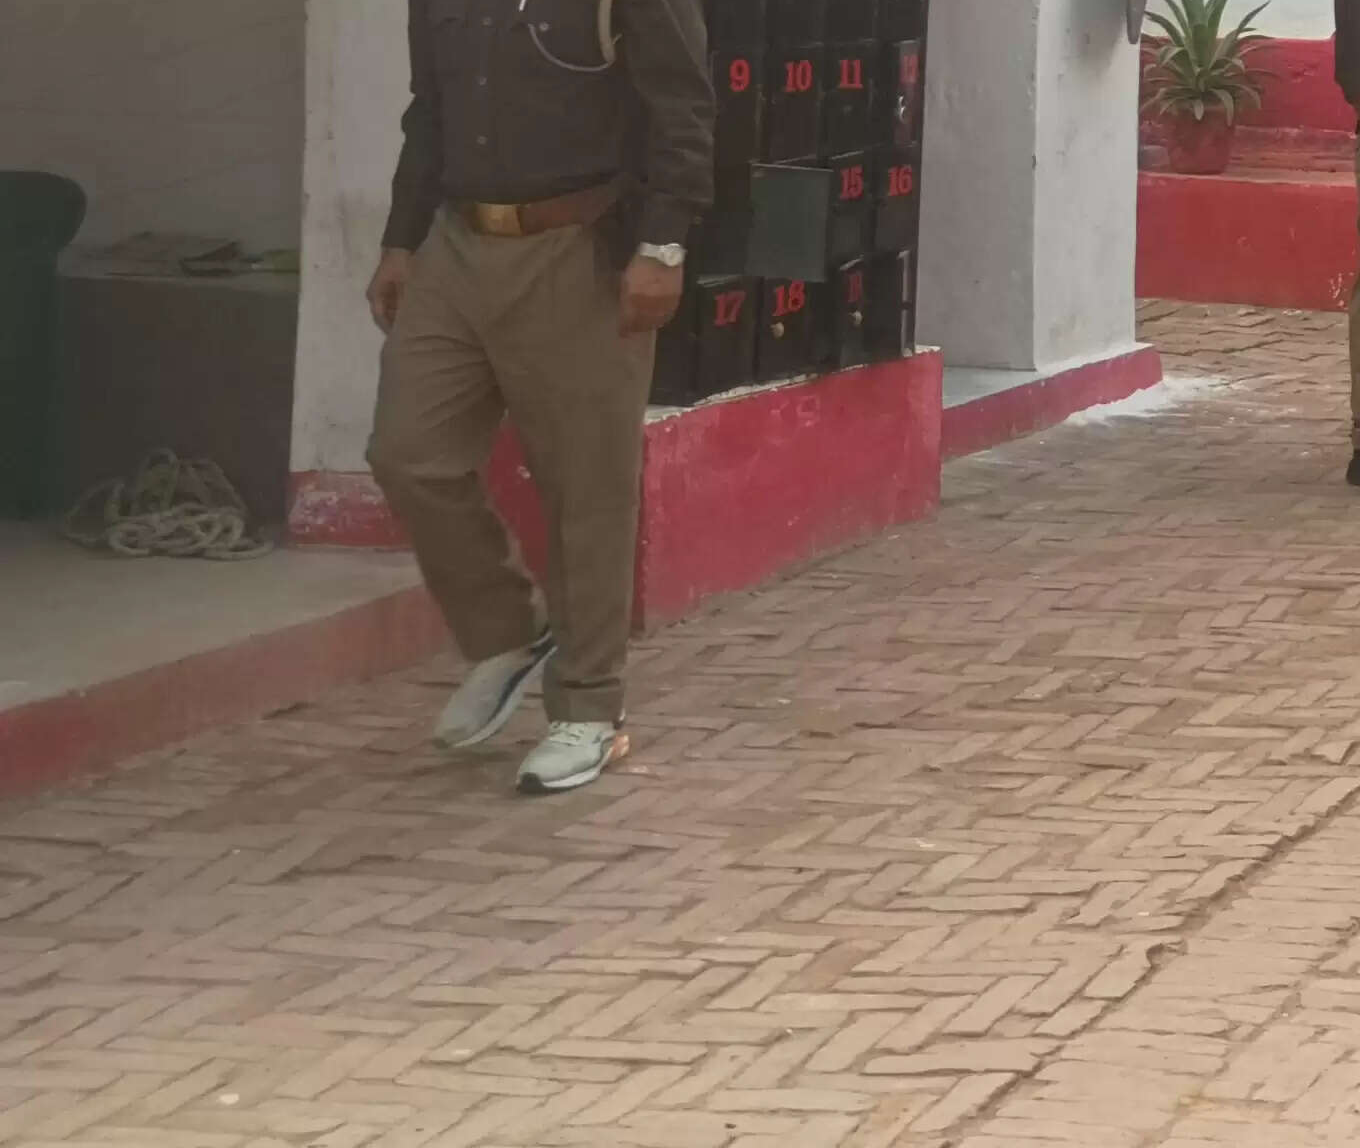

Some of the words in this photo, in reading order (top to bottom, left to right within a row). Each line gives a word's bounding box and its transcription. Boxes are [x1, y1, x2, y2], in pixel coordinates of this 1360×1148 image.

[730, 59, 750, 91] 9
[785, 60, 812, 93] 10
[839, 59, 864, 89] 11
[840, 165, 864, 199] 15
[887, 165, 913, 196] 16
[713, 291, 745, 326] 17
[773, 280, 805, 316] 18
